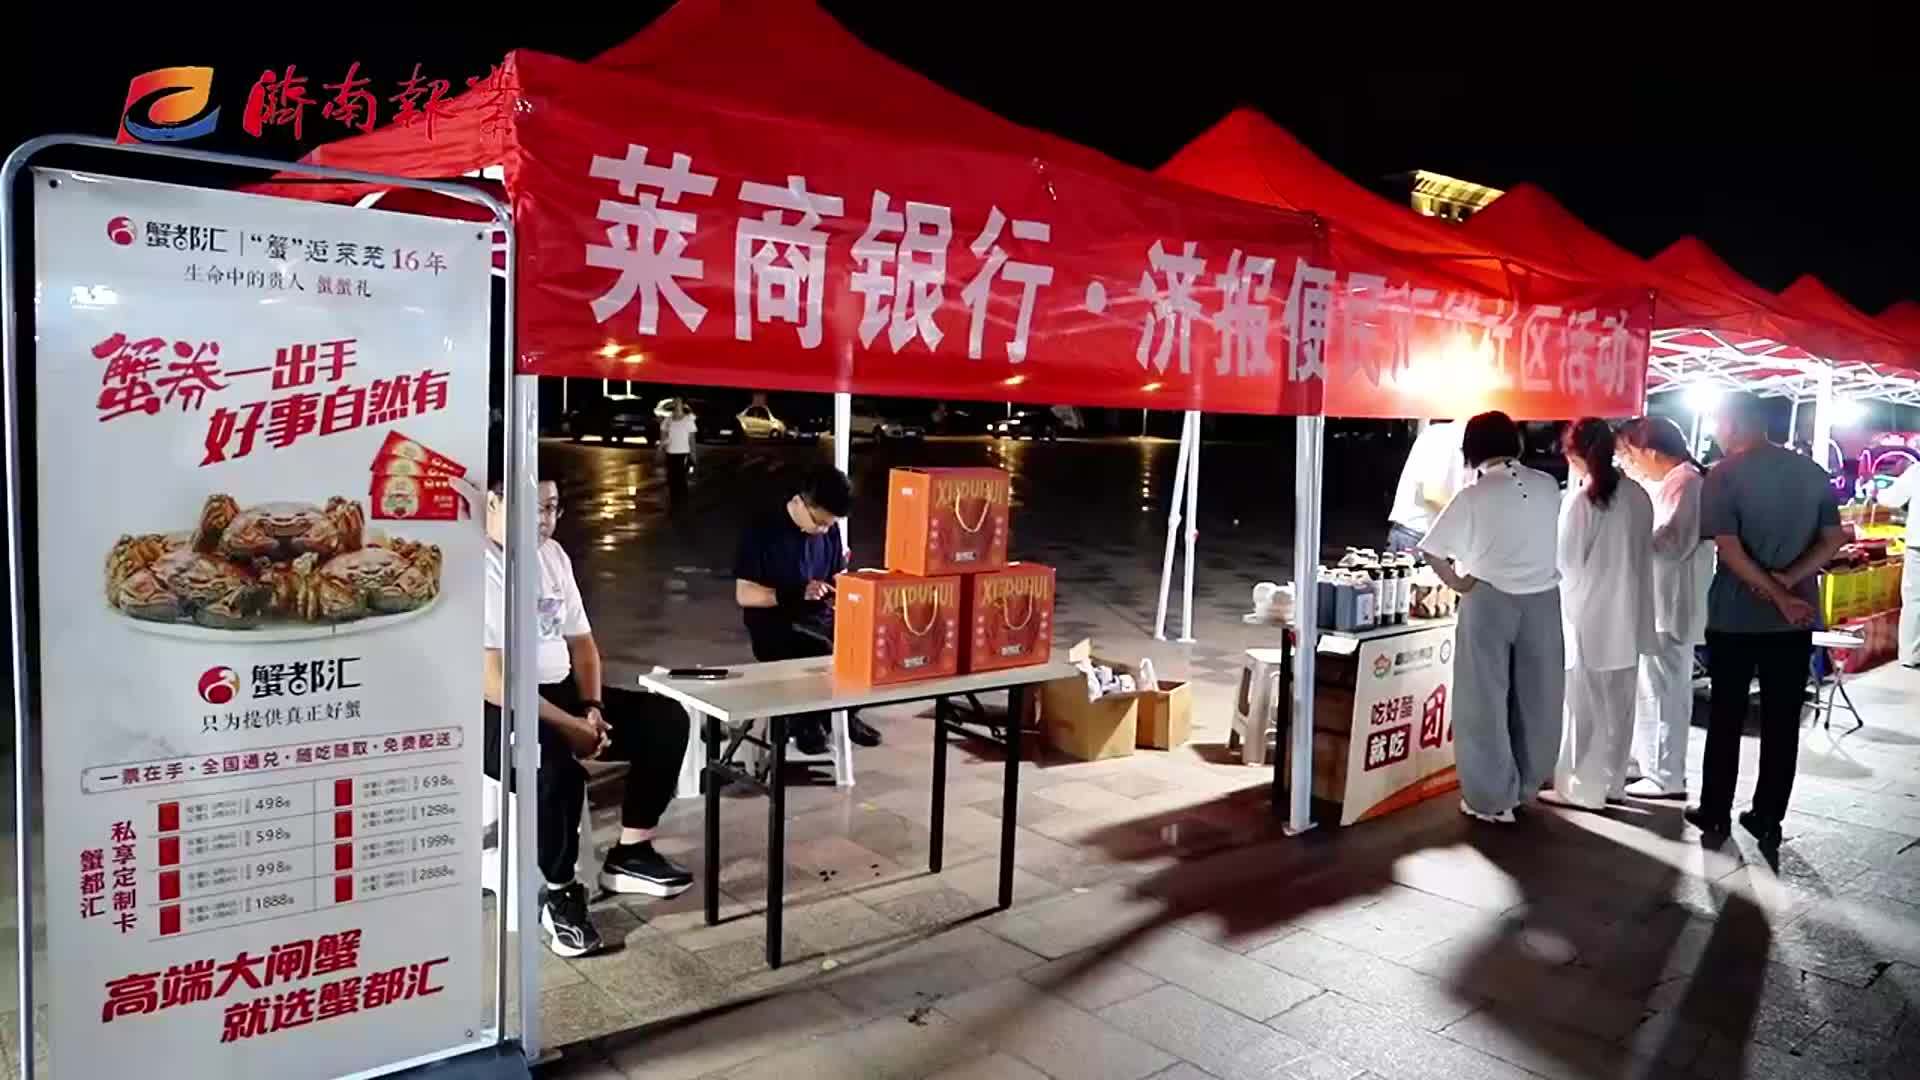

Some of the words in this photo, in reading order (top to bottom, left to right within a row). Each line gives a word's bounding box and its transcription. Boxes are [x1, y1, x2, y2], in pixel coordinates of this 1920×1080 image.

[145, 221, 228, 253] 蟹都汇
[184, 264, 304, 291] 生命中的贵人
[91, 333, 358, 422] 蟹券一出手
[198, 368, 450, 467] 好事自然有
[251, 657, 362, 699] 蟹都汇
[201, 700, 361, 734] 只为提供真正好蟹
[1371, 694, 1414, 725] 吃好醋
[1369, 731, 1406, 766] 就吃
[80, 848, 105, 918] 蟹都汇
[111, 820, 137, 934] 私享定制卡
[102, 929, 362, 1023] 高端大闸蟹
[220, 956, 449, 1043] 就选蟹都汇
